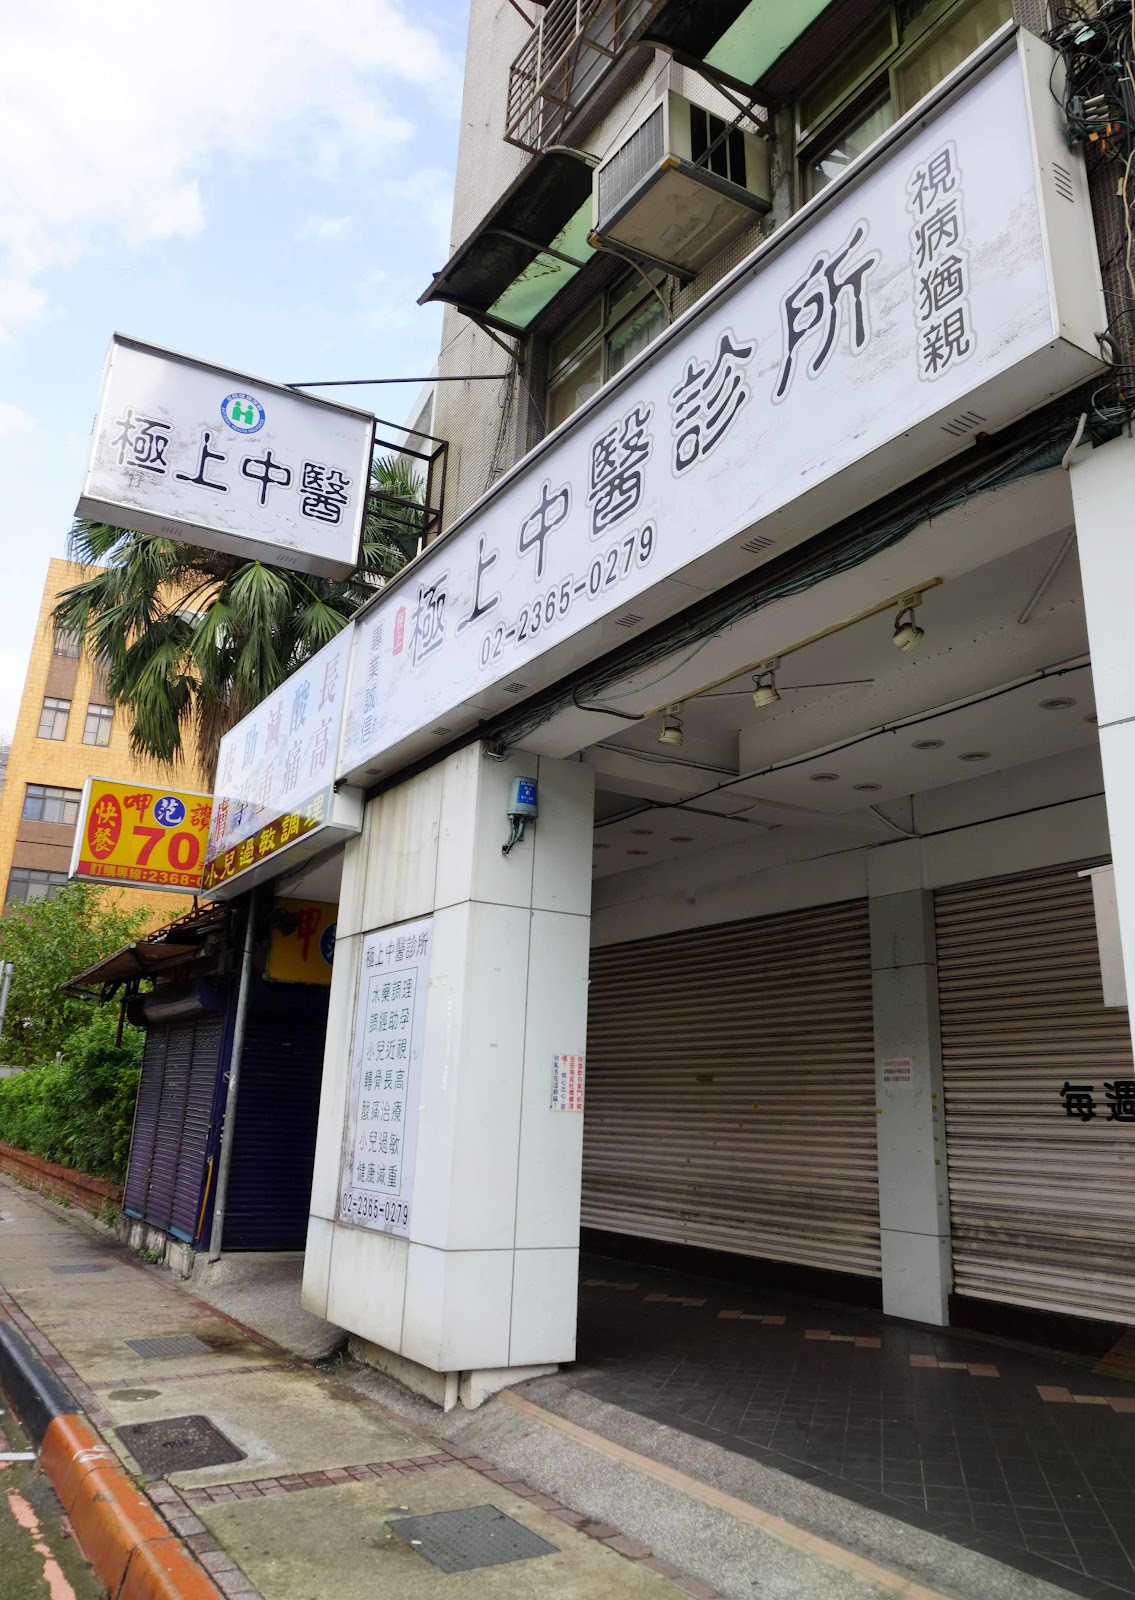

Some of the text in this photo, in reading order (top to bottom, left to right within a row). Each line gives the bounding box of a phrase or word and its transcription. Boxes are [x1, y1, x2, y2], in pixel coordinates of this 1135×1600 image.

[910, 147, 971, 374] 視病猶親
[111, 408, 351, 524] 極上中醫
[408, 227, 875, 668] 極上中醫診所
[480, 524, 654, 665] 02-2365-0279
[90, 800, 119, 852] 快餐
[204, 793, 325, 888] 小兒過敏調理
[365, 932, 428, 968] 極上中醫診所
[366, 1038, 407, 1062] 小兒近視
[360, 1100, 402, 1122] 酸痛治療
[1060, 1081, 1135, 1122] 每週
[358, 1130, 400, 1155] 小兒過敏
[356, 1161, 398, 1188] 健康減重
[342, 1192, 409, 1226] 02-2365-0279
